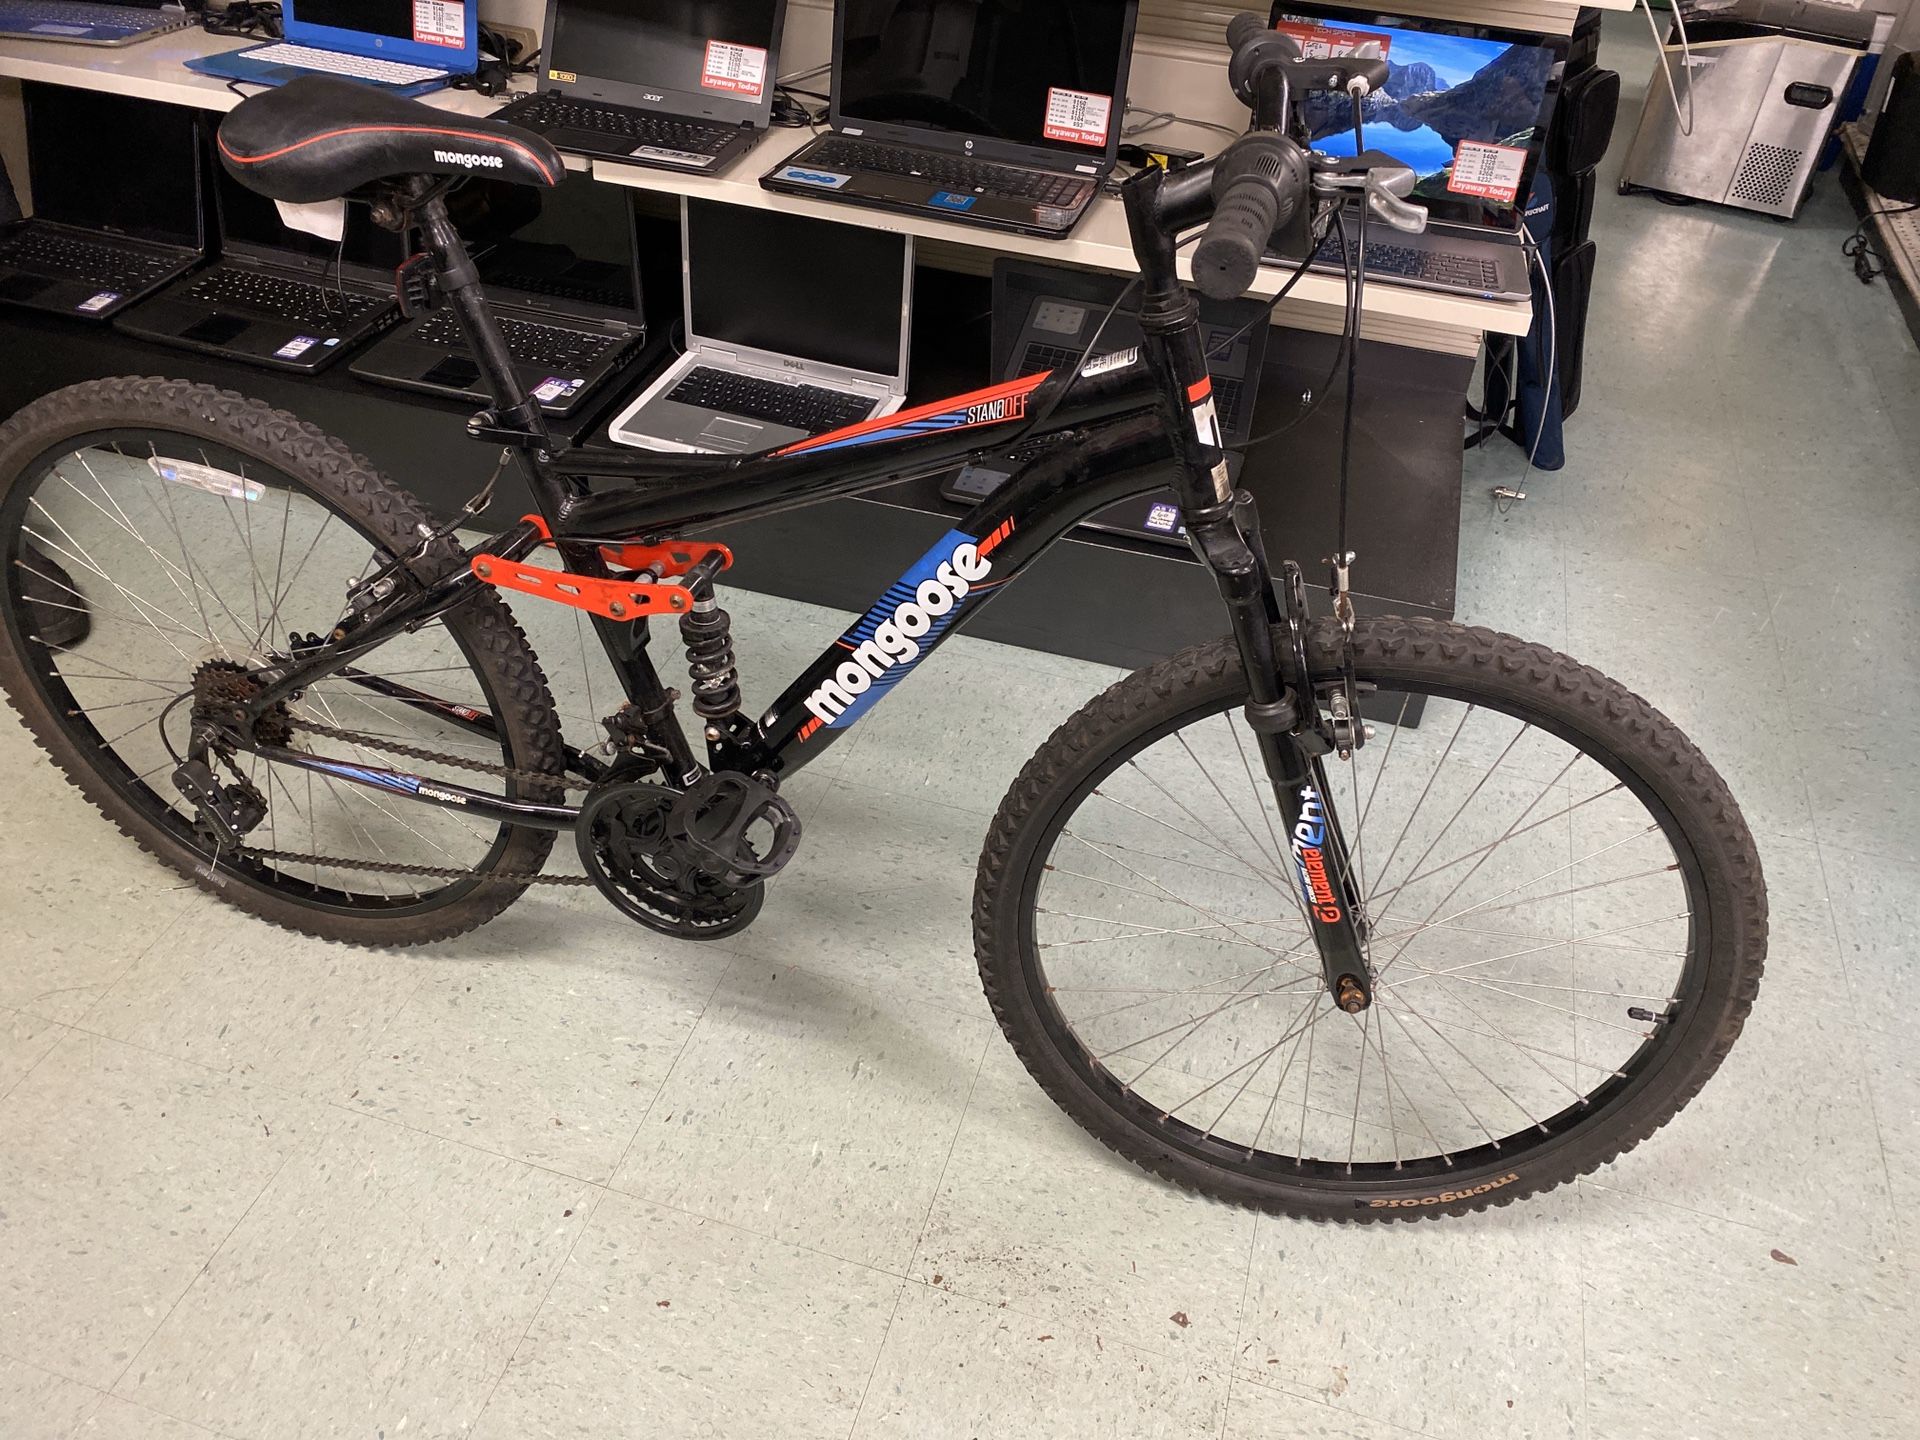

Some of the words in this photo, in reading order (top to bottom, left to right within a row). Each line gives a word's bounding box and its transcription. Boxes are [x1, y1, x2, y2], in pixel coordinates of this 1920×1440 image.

[416, 31, 442, 44] Layaway
[444, 36, 464, 48] Today
[1313, 26, 1332, 34] TECH
[1332, 29, 1356, 38] SPECS
[704, 76, 736, 90] Layaway
[738, 82, 758, 93] Today
[643, 92, 664, 102] acer
[1047, 126, 1080, 140] Layaway
[1080, 132, 1104, 144] Today
[434, 150, 504, 168] mongoose
[1452, 181, 1487, 194] Layaway
[1488, 186, 1512, 199] Today
[784, 360, 804, 370] DELL
[968, 392, 1028, 424] STANDOFF
[804, 543, 992, 725] mongoose
[418, 786, 466, 804] mongoose
[1302, 848, 1336, 904] element
[1370, 1172, 1520, 1208] mongoose
